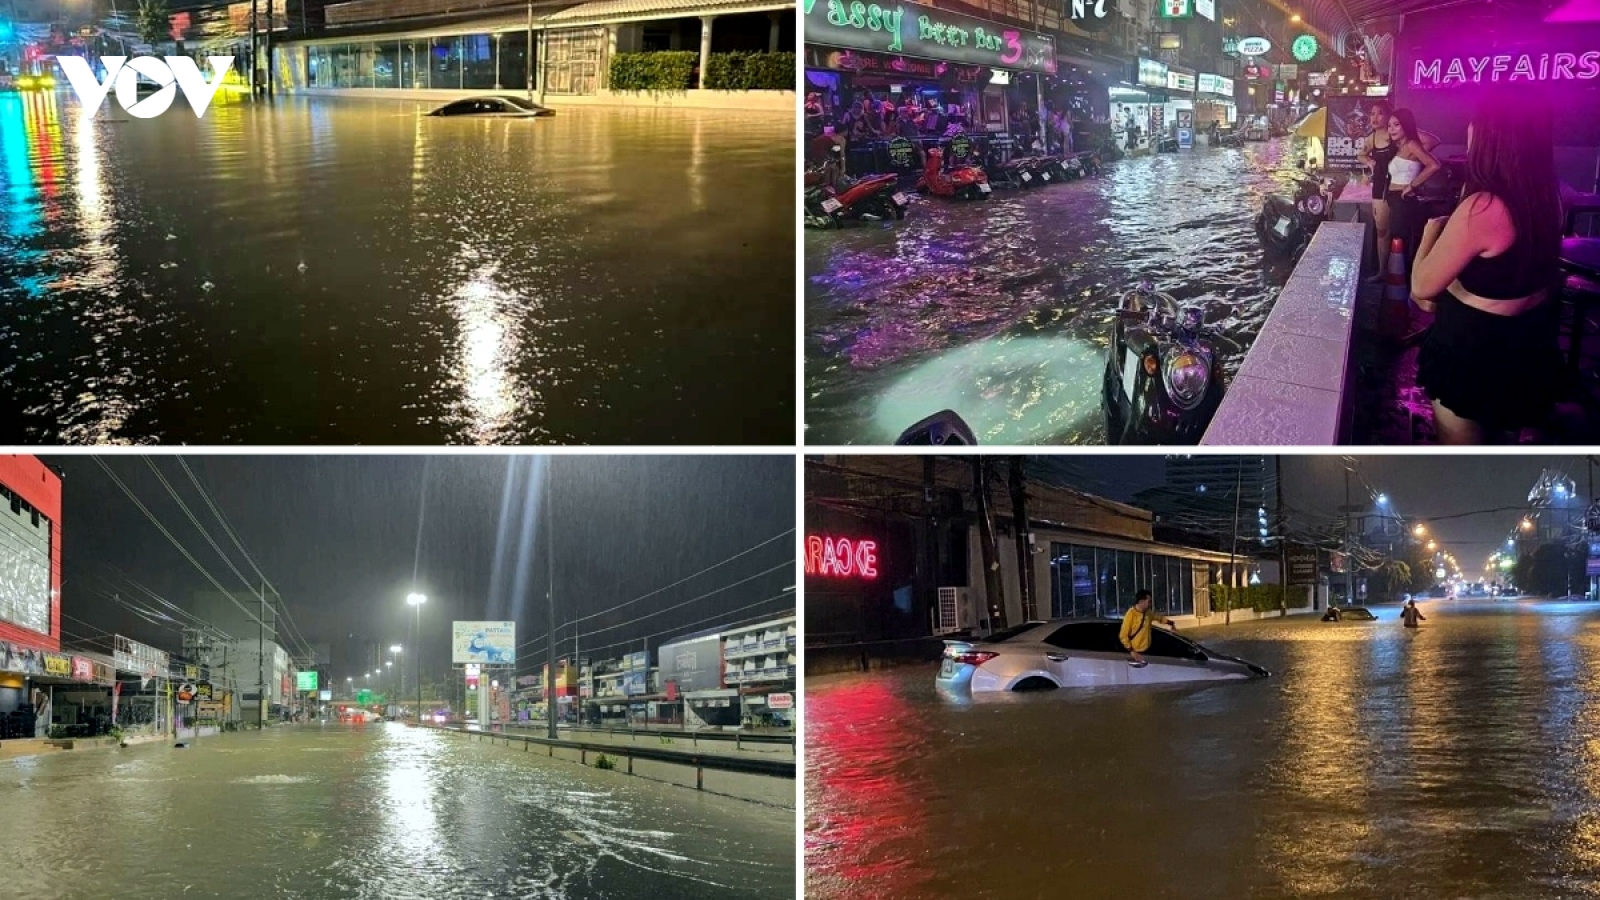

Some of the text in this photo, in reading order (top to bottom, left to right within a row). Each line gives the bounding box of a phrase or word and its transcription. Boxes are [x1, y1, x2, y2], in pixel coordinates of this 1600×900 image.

[918, 15, 968, 46] Beer
[974, 27, 1002, 51] Bar
[1000, 31, 1021, 64] 3
[1413, 51, 1600, 84] MAYFAIRS
[1328, 147, 1357, 156] DISPEN
